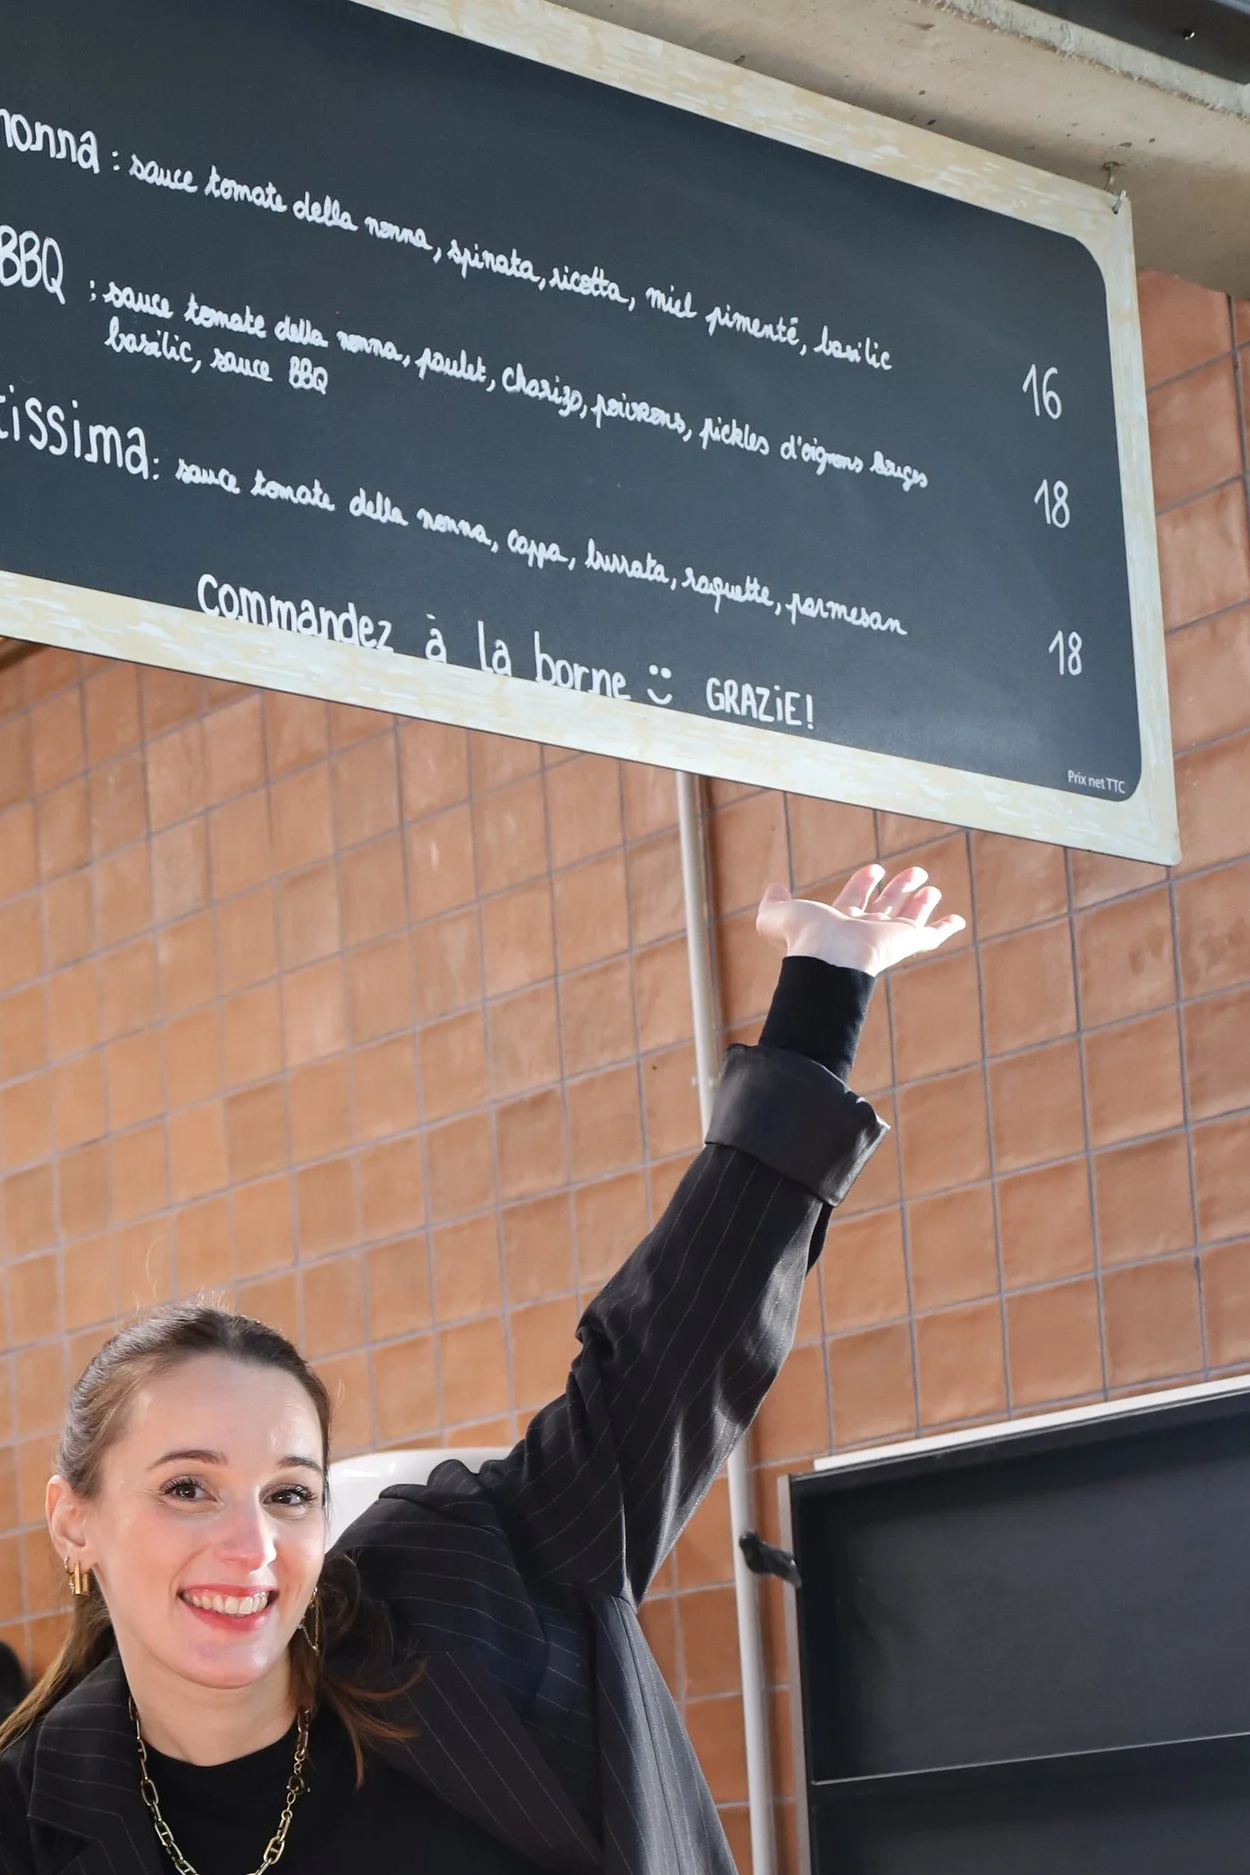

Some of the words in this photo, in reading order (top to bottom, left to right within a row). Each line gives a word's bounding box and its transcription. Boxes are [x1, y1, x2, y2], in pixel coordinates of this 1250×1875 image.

[128, 154, 198, 193] sauce
[204, 165, 288, 213] tomate
[292, 191, 359, 231] della
[364, 216, 442, 264] nonna,
[548, 265, 636, 312] ricotta,
[645, 284, 698, 319] miel
[813, 325, 893, 371] basilic
[102, 281, 174, 319] sauce
[183, 292, 267, 339] tomate
[273, 315, 329, 348] della
[336, 330, 411, 368] nonna,
[414, 347, 496, 392] poulet,
[698, 416, 770, 456] pickles
[104, 315, 202, 374] basilic,
[209, 347, 274, 382] sauce
[288, 355, 329, 395] BBQ
[1022, 363, 1062, 420] 16
[1033, 478, 1071, 529] 18
[174, 458, 241, 495] sauce
[250, 469, 336, 512] tomate
[349, 487, 409, 527] della
[416, 507, 499, 554] nonna,
[584, 538, 677, 591] burrata,
[680, 566, 782, 616] roquette,
[784, 592, 908, 636] parmesan
[197, 573, 394, 652] Commandez
[425, 613, 447, 664] à
[477, 620, 512, 677] la
[534, 630, 632, 700] borne
[1048, 630, 1083, 676] 18
[1068, 769, 1087, 786] Prix
[1088, 776, 1105, 790] net
[1105, 777, 1126, 794] TTC
